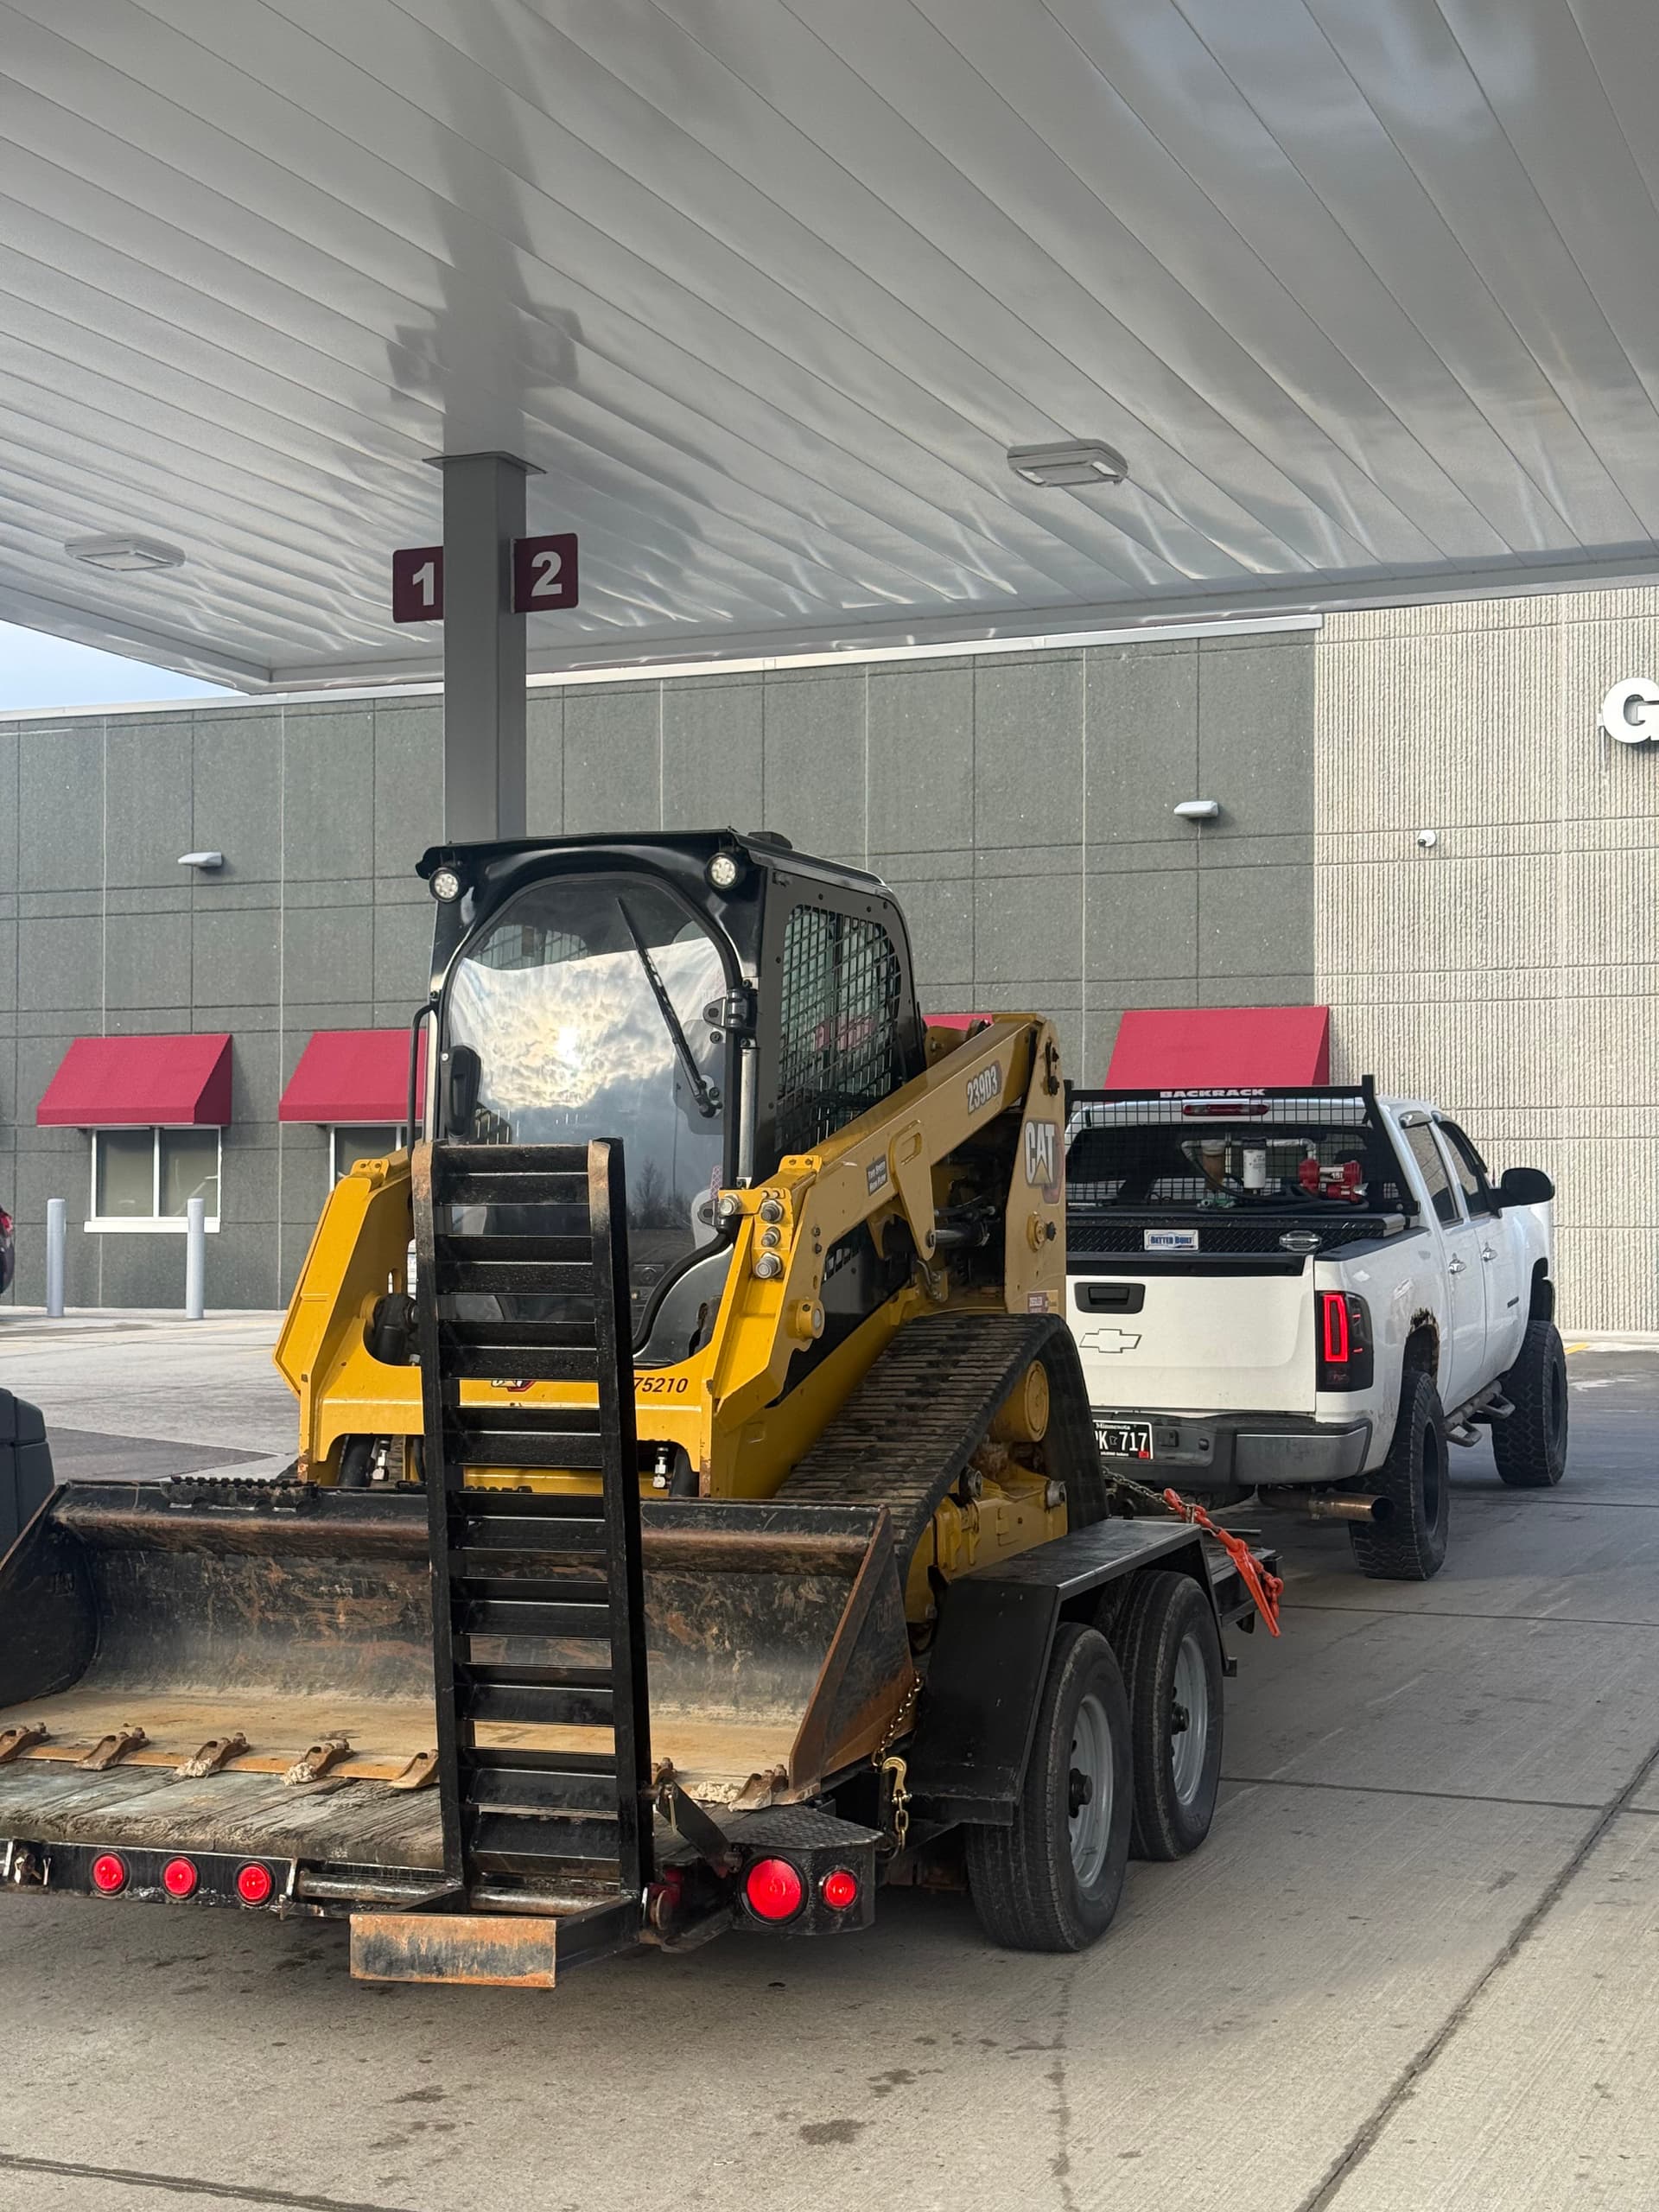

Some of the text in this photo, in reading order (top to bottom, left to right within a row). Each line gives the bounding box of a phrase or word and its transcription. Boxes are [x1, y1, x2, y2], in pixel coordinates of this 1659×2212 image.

[412, 562, 435, 606] 1
[531, 550, 563, 597] 2
[1602, 677, 1659, 743] G
[967, 1065, 998, 1113] 239D3
[1160, 1089, 1266, 1098] BACKRACK
[1025, 1122, 1055, 1185] CAT
[633, 1377, 689, 1393] 75210
[1094, 1430, 1147, 1452] K 717
